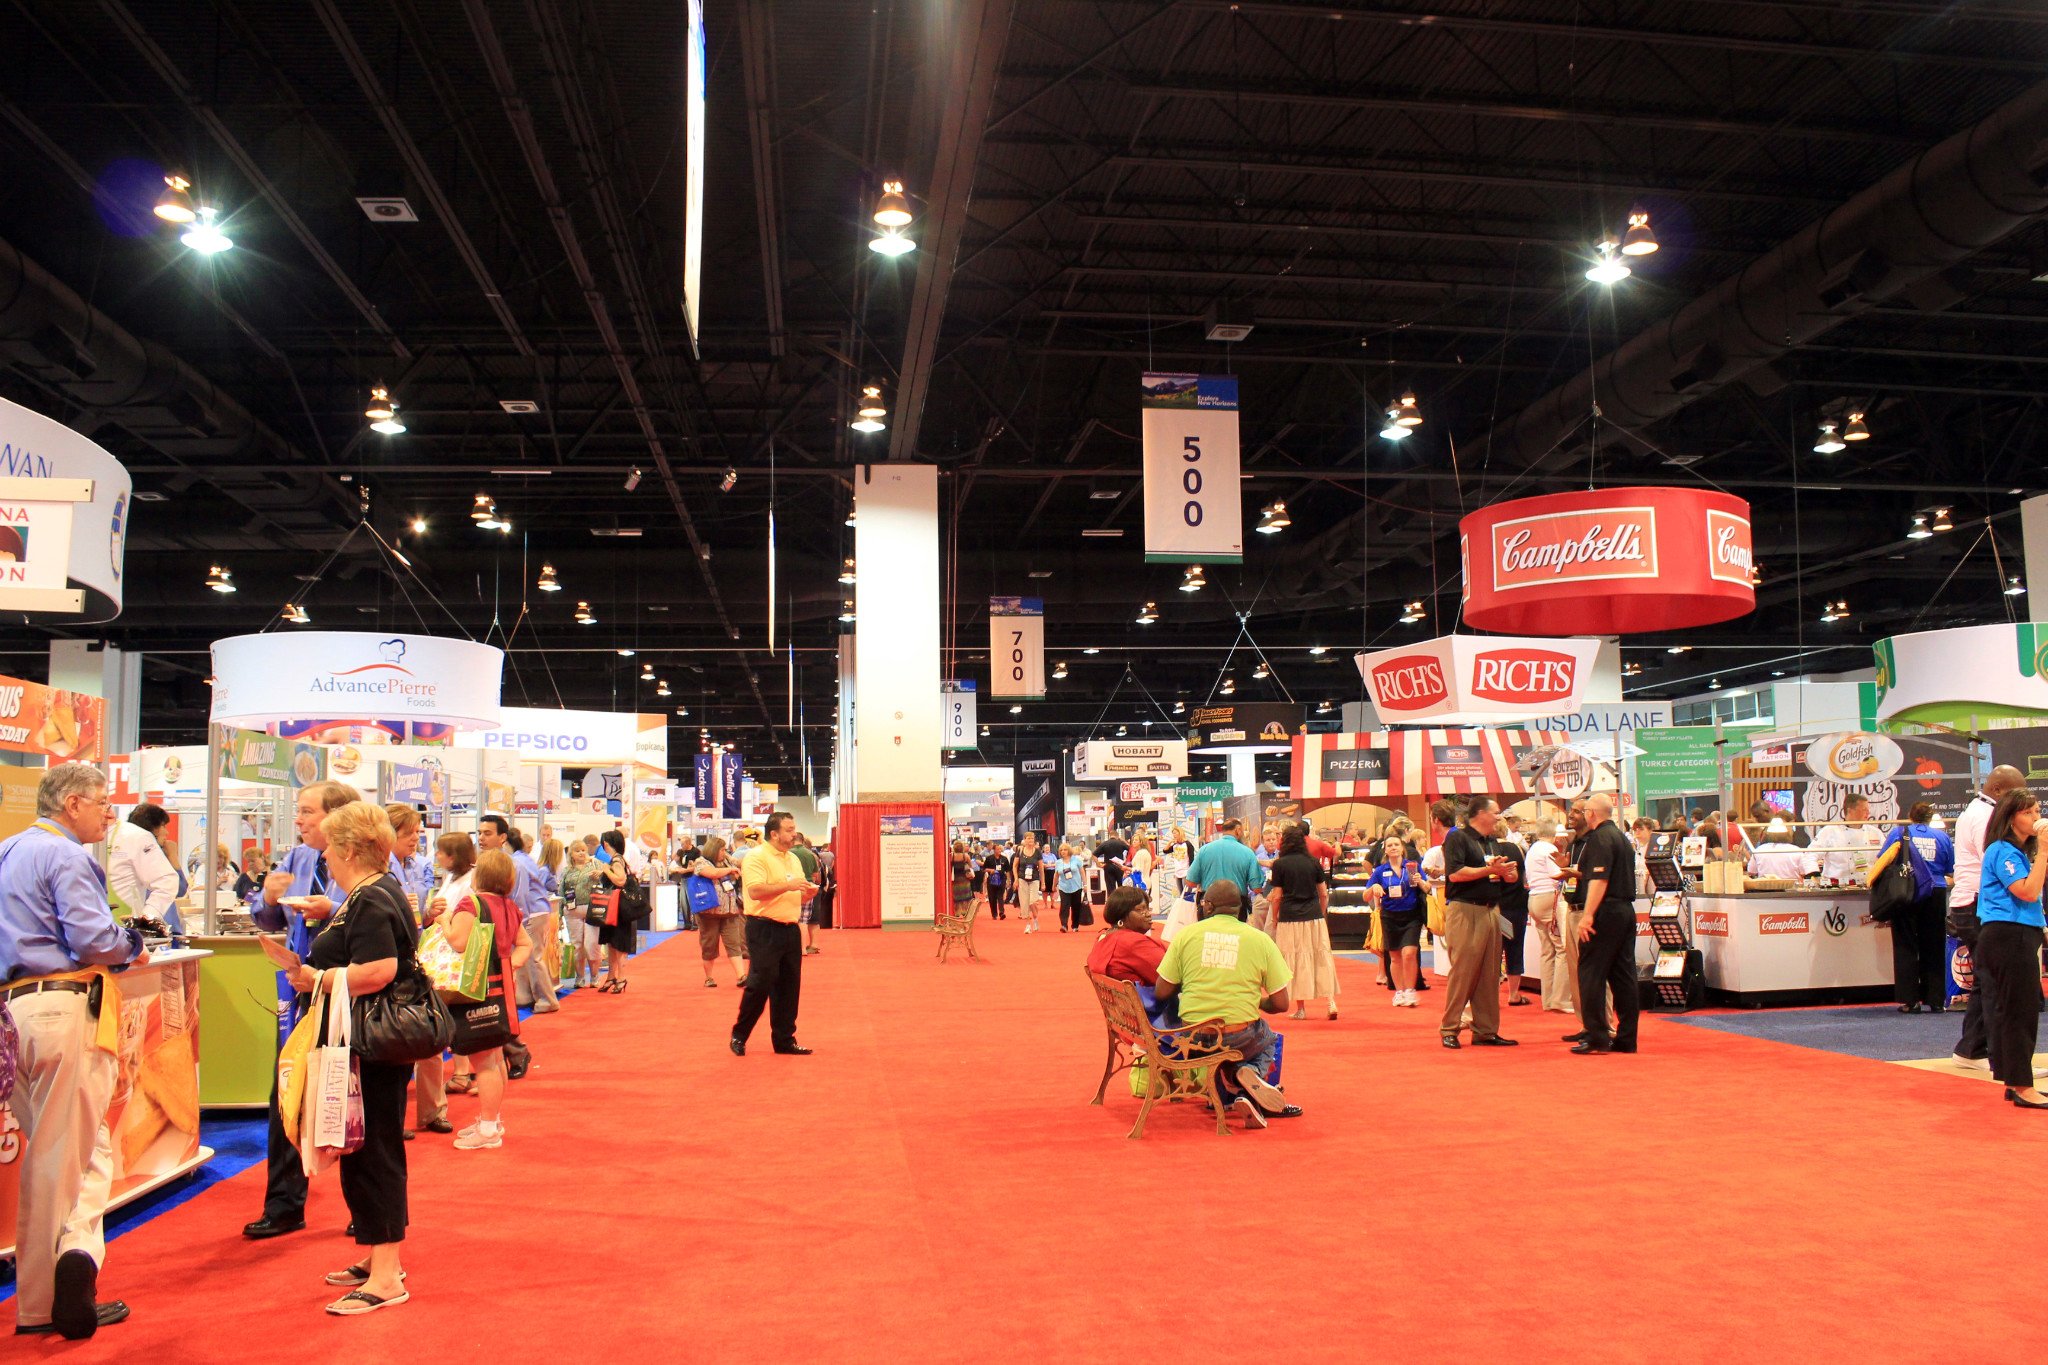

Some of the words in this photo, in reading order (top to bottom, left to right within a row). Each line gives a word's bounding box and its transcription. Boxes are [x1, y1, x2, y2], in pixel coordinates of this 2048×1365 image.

[1183, 436, 1203, 527] 500
[1501, 524, 1645, 573] Campbell's
[1012, 631, 1023, 681] 700
[1375, 664, 1445, 702] RICH'S
[1475, 659, 1572, 694] RICH'S
[310, 677, 437, 696] AdvancePierre
[407, 697, 436, 708] Foods
[954, 702, 962, 737] 900
[1535, 712, 1599, 732] USDA
[1606, 711, 1663, 731] LANE
[484, 733, 588, 750] PEPSICO
[636, 742, 665, 752] Tropicana
[240, 739, 276, 767] AMAZING
[1839, 743, 1873, 764] Goldfish
[1024, 762, 1052, 770] VULCAN
[1330, 760, 1381, 770] PIZZERIA
[1553, 760, 1579, 774] SOUPED
[1674, 759, 1714, 767] CATEGORY
[698, 767, 706, 800] Jackson
[726, 768, 735, 800] Delfield
[1176, 786, 1218, 797] Friendly
[1131, 791, 1144, 799] BAK
[1696, 914, 1728, 934] Campbell's
[1761, 916, 1806, 933] Campbell's
[1825, 902, 1846, 932] V8
[1204, 931, 1240, 946] DRINK
[1201, 948, 1238, 966] GOOD
[466, 1004, 500, 1019] CAMBRO
